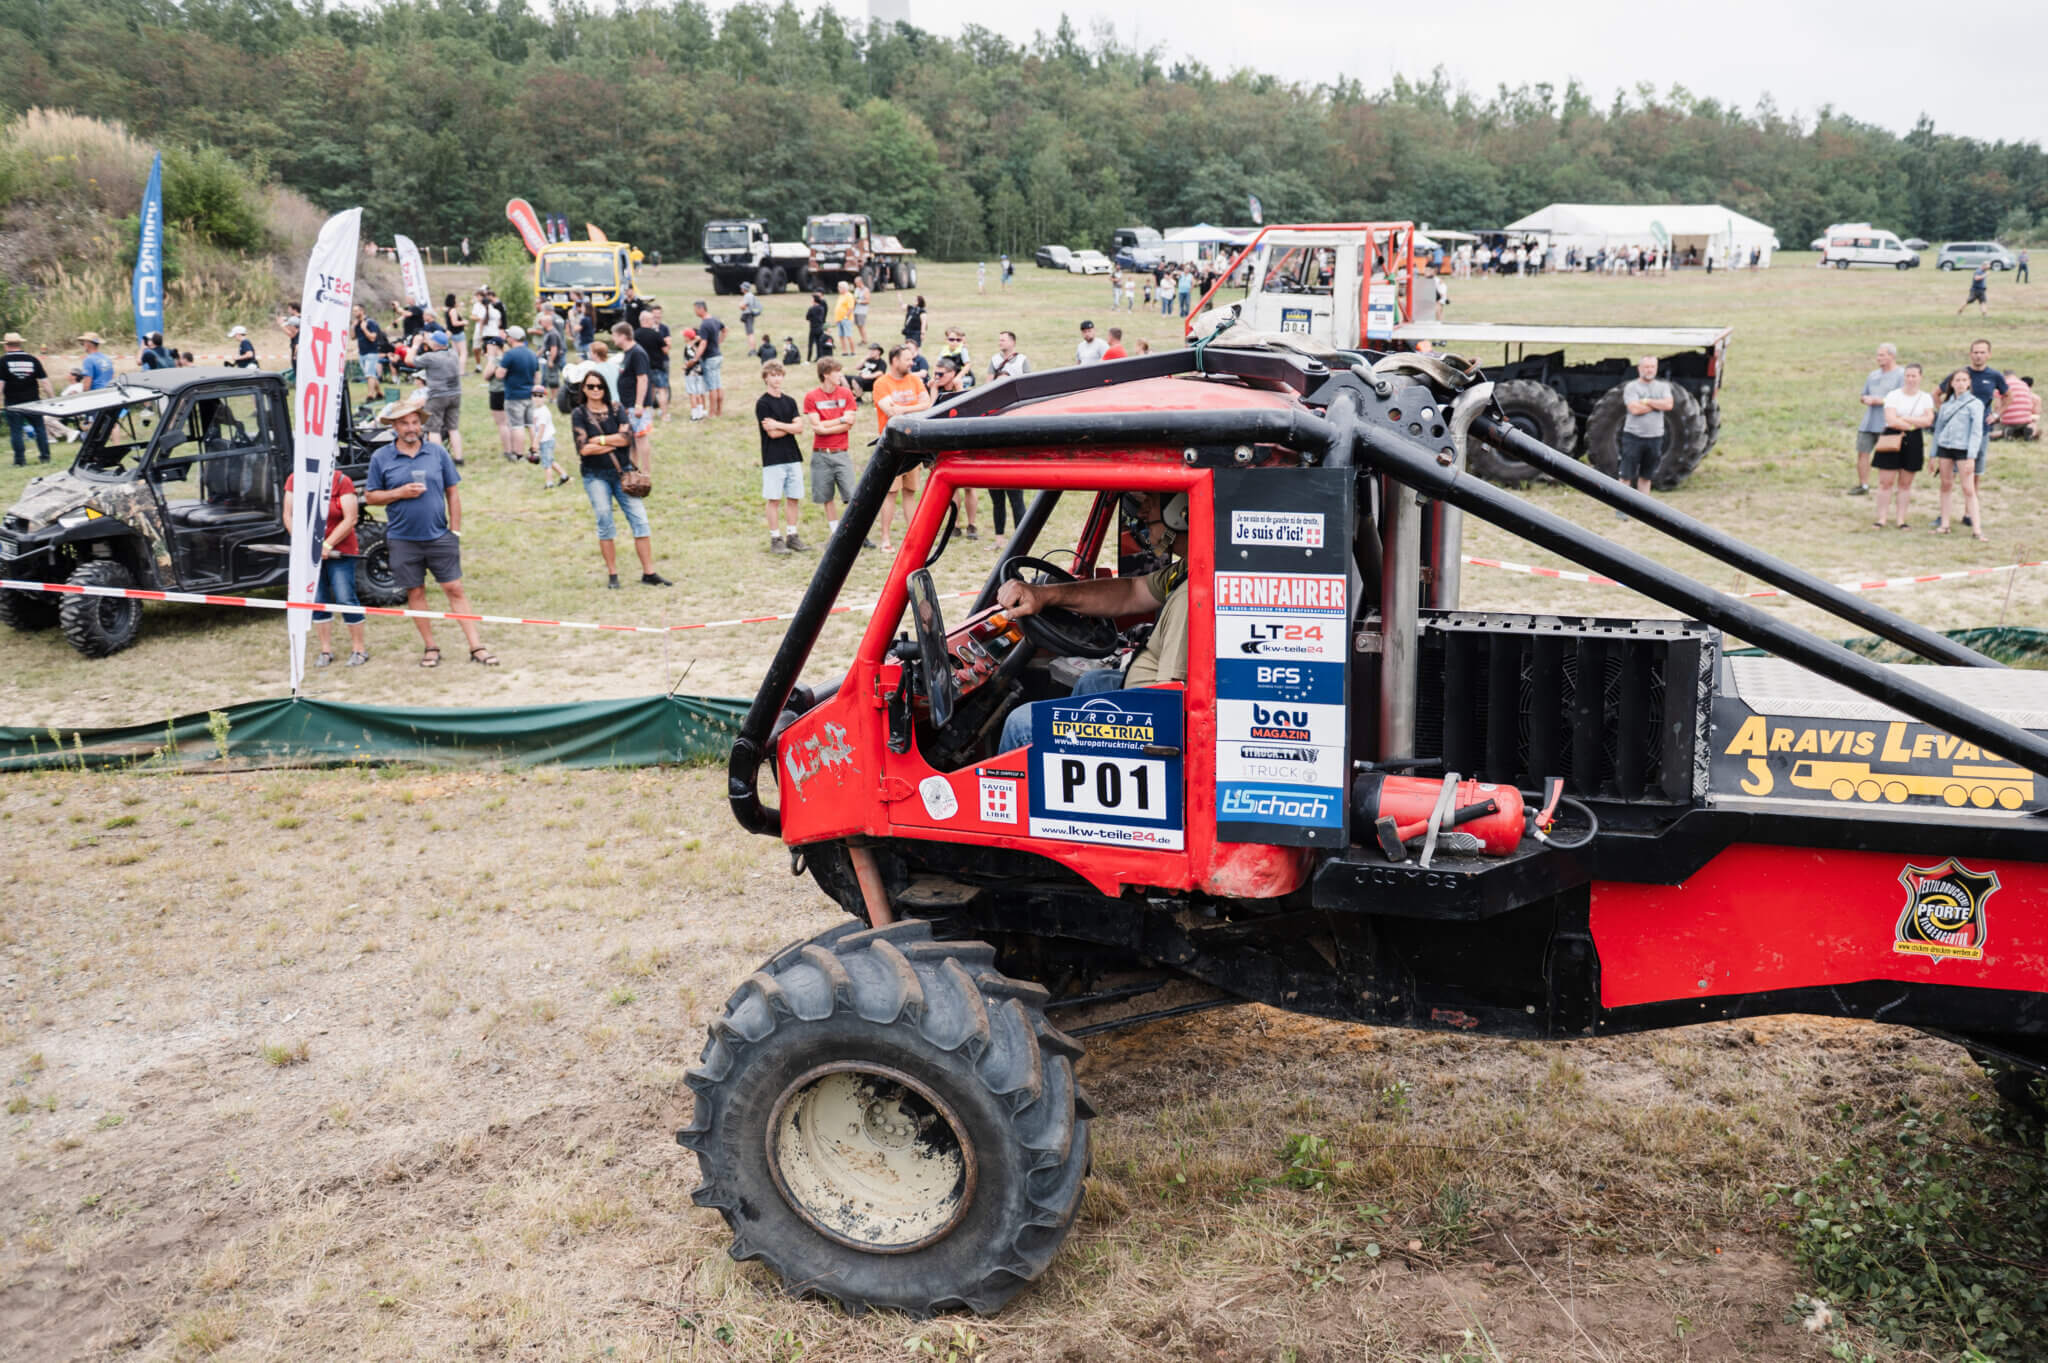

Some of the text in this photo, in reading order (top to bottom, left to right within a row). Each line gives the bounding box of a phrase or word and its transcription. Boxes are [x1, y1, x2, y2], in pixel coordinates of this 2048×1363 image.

[1237, 524, 1304, 541] Je suis d'ici!
[1218, 576, 1344, 607] FERNFAHRER
[1250, 624, 1324, 641] LT24
[1263, 643, 1324, 654] lkw-teile24
[1257, 667, 1300, 684] BFS
[1053, 711, 1153, 726] EUROPA
[1253, 703, 1308, 728] bau
[1054, 723, 1153, 740] TRUCK-TRIAL
[1252, 728, 1309, 740] MAGAZIN
[1880, 722, 2011, 763] LEVA
[982, 783, 1014, 792] SAVOIE
[1061, 759, 1149, 810] P01
[986, 811, 1010, 819] LIBRE
[1042, 826, 1170, 844] www.lkw-teile24.de
[1918, 903, 1970, 920] PFORTE
